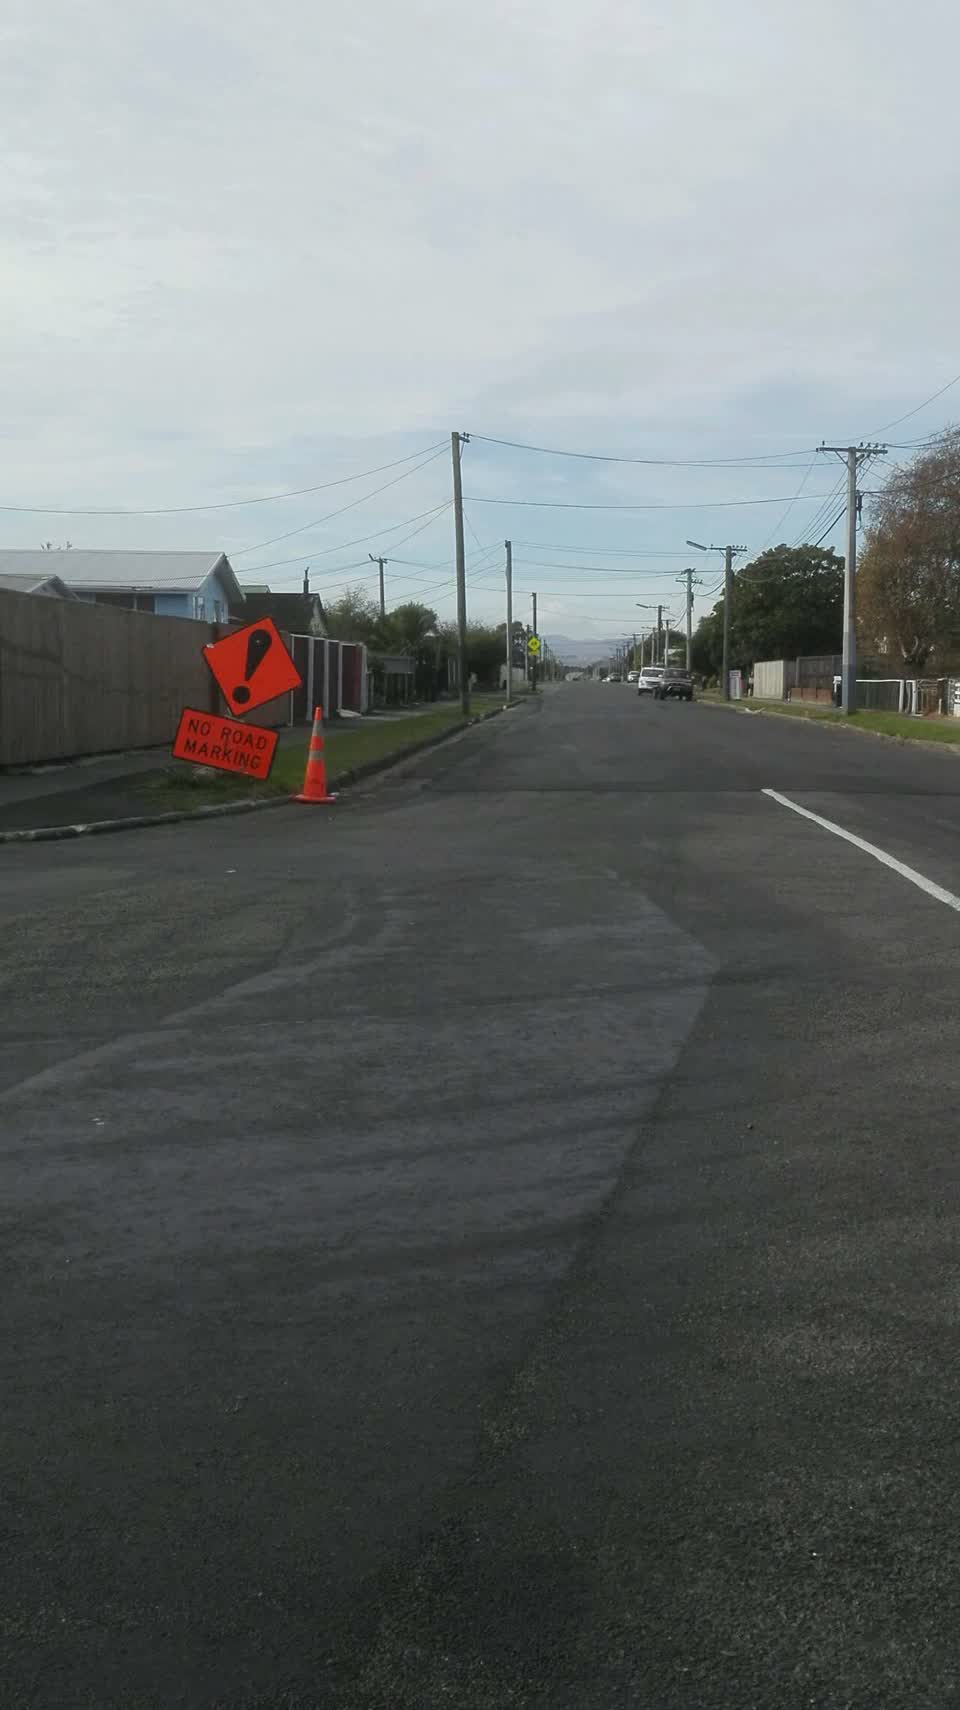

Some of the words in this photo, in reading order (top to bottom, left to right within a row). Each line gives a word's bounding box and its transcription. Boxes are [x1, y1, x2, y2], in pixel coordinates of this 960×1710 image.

[188, 719, 211, 737] NO
[221, 726, 267, 750] ROAD
[183, 738, 261, 769] MARKING
